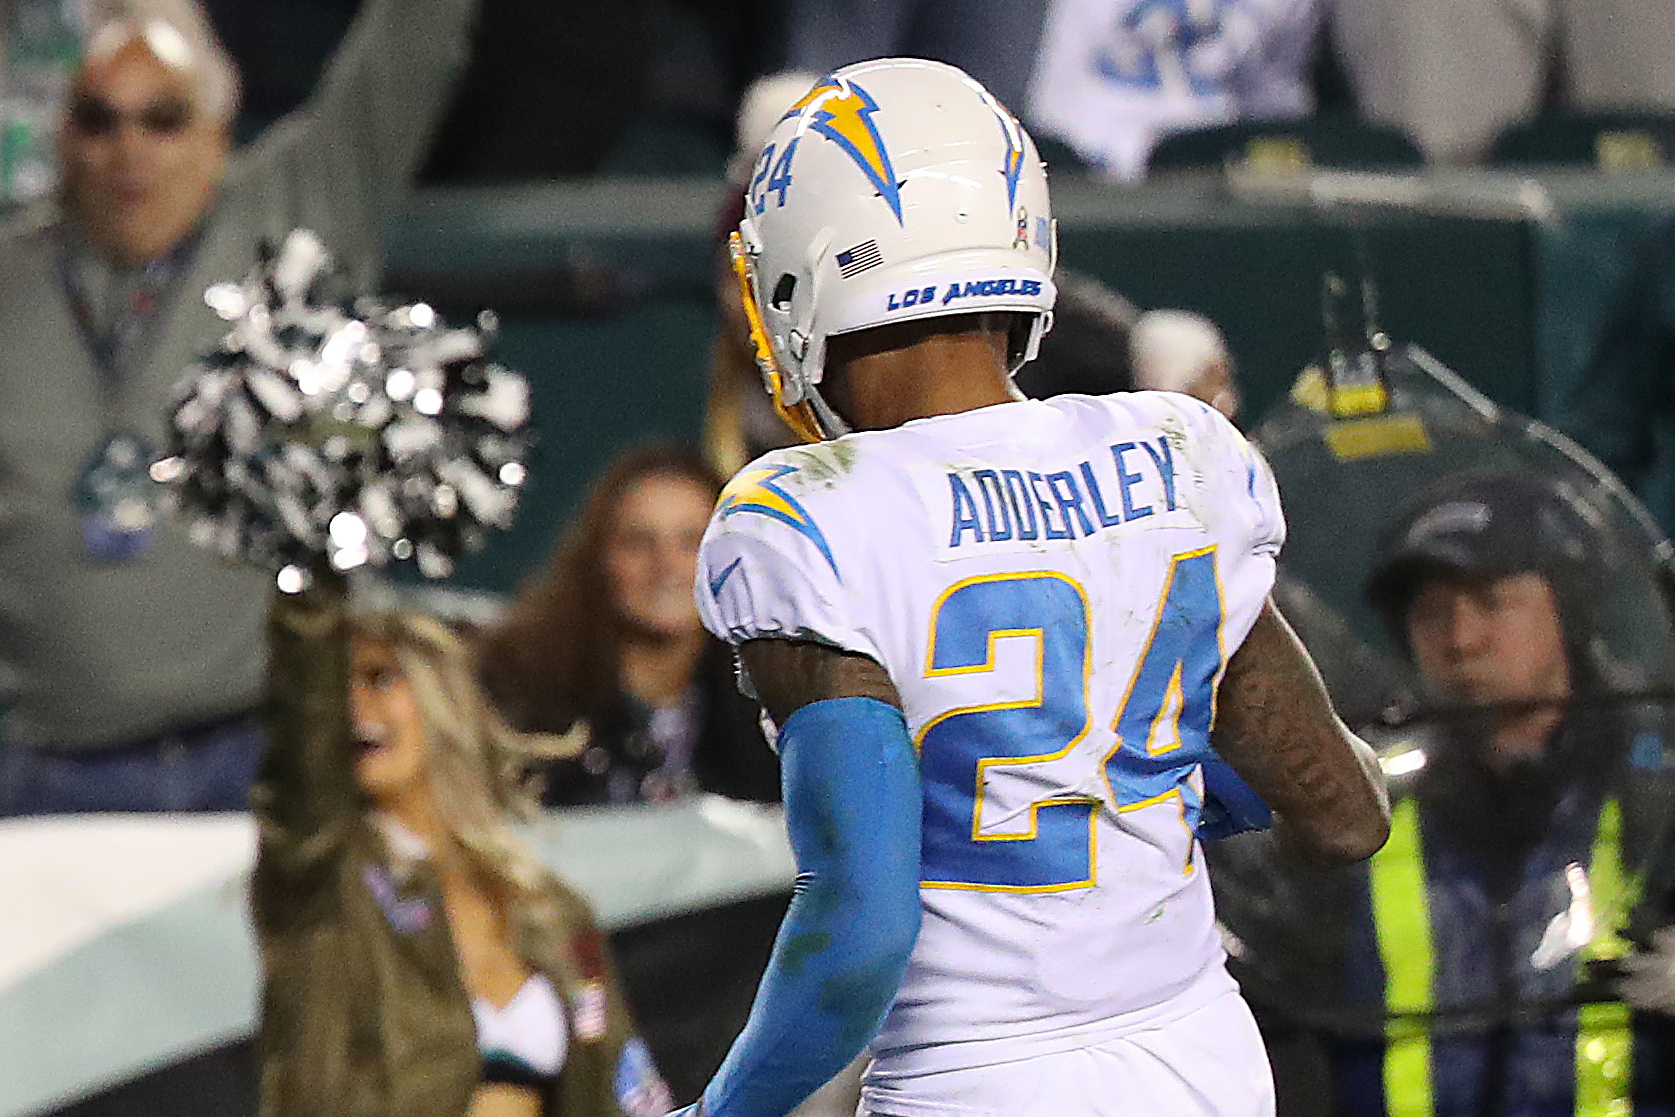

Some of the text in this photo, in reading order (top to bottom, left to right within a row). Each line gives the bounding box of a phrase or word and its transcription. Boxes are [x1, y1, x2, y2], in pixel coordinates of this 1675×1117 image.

[752, 135, 801, 215] 24
[887, 279, 1043, 311] LOS ANGELES
[947, 435, 1176, 548] ADDERLEY
[914, 545, 1226, 895] 24
